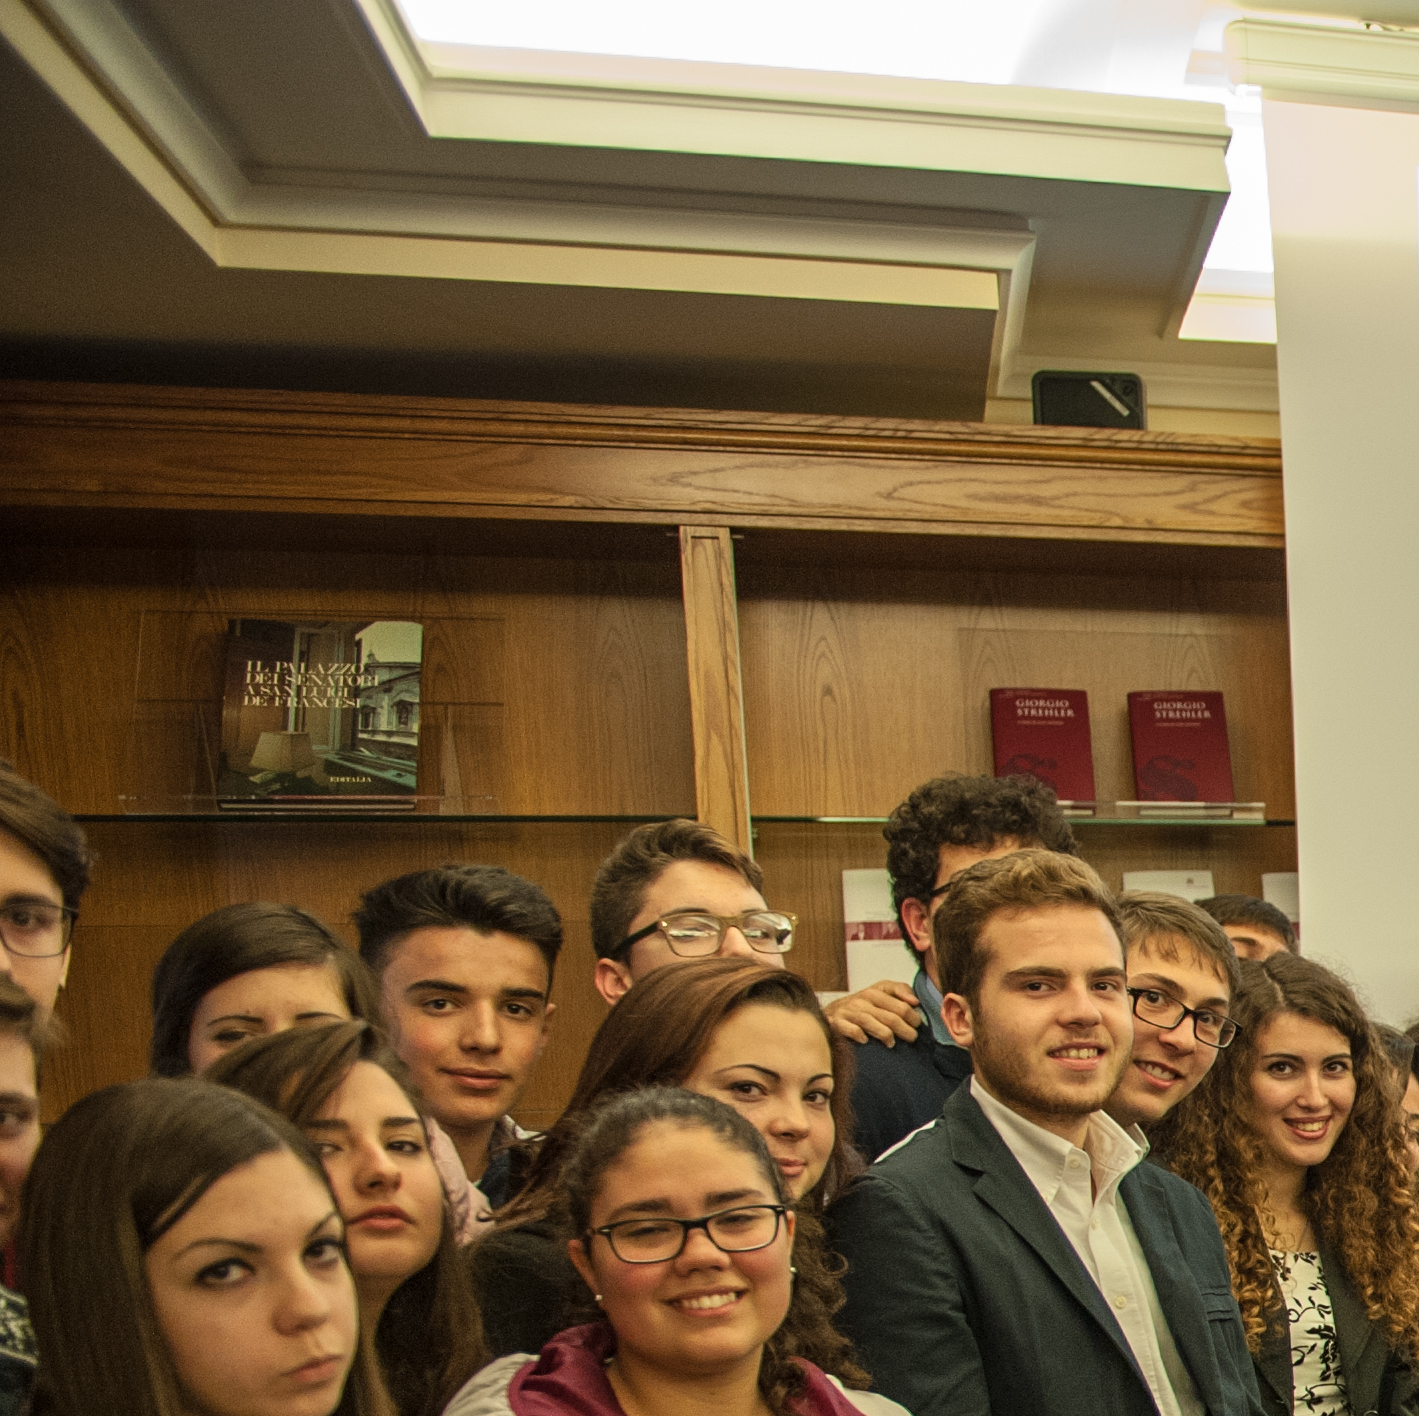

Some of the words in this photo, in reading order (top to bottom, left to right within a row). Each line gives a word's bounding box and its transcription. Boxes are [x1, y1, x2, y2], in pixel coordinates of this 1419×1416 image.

[247, 661, 270, 674] IL
[275, 661, 365, 675] PALAZZO
[246, 673, 278, 685] DEI
[285, 674, 379, 687] SENATORI
[302, 686, 349, 698] LUIGI
[274, 696, 361, 709] FRANCESI
[1015, 699, 1070, 708] GIORGIO
[1153, 701, 1207, 710] GIORGIO
[1016, 708, 1075, 718] STREHLER
[1155, 710, 1212, 719] STREHLER
